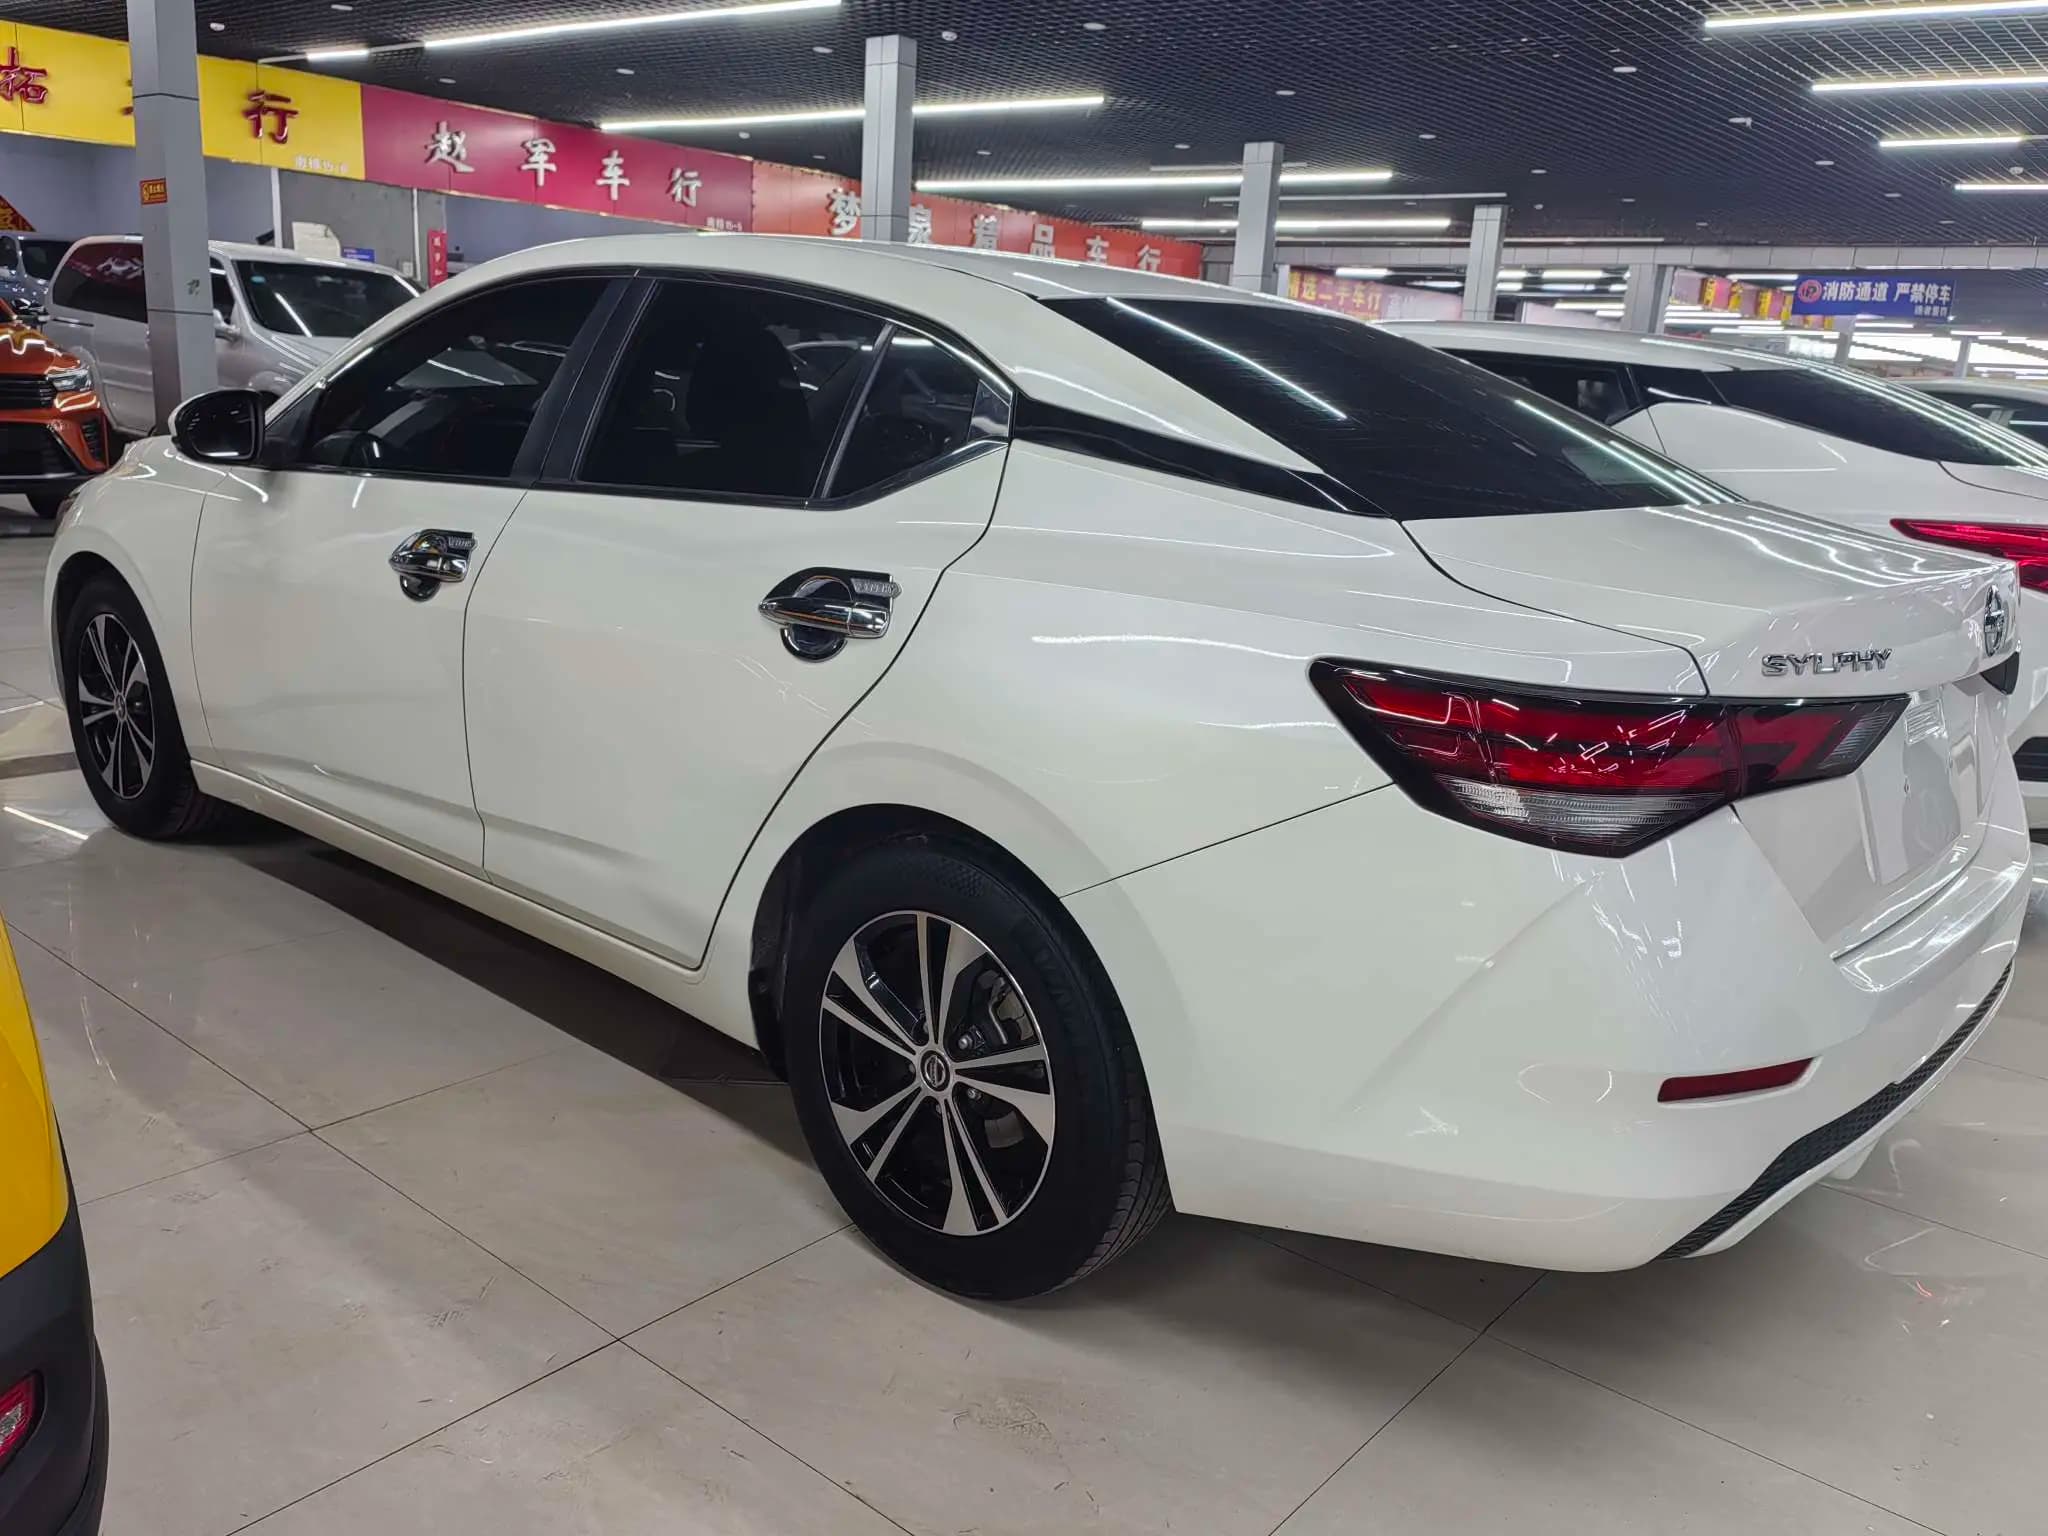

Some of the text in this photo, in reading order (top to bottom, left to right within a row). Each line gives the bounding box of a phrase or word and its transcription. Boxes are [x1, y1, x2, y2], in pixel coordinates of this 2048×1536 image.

[424, 120, 703, 208] 赵军车行
[1822, 281, 1952, 306] 消防通道 严禁停车
[1761, 648, 1893, 677] SYLPHY
